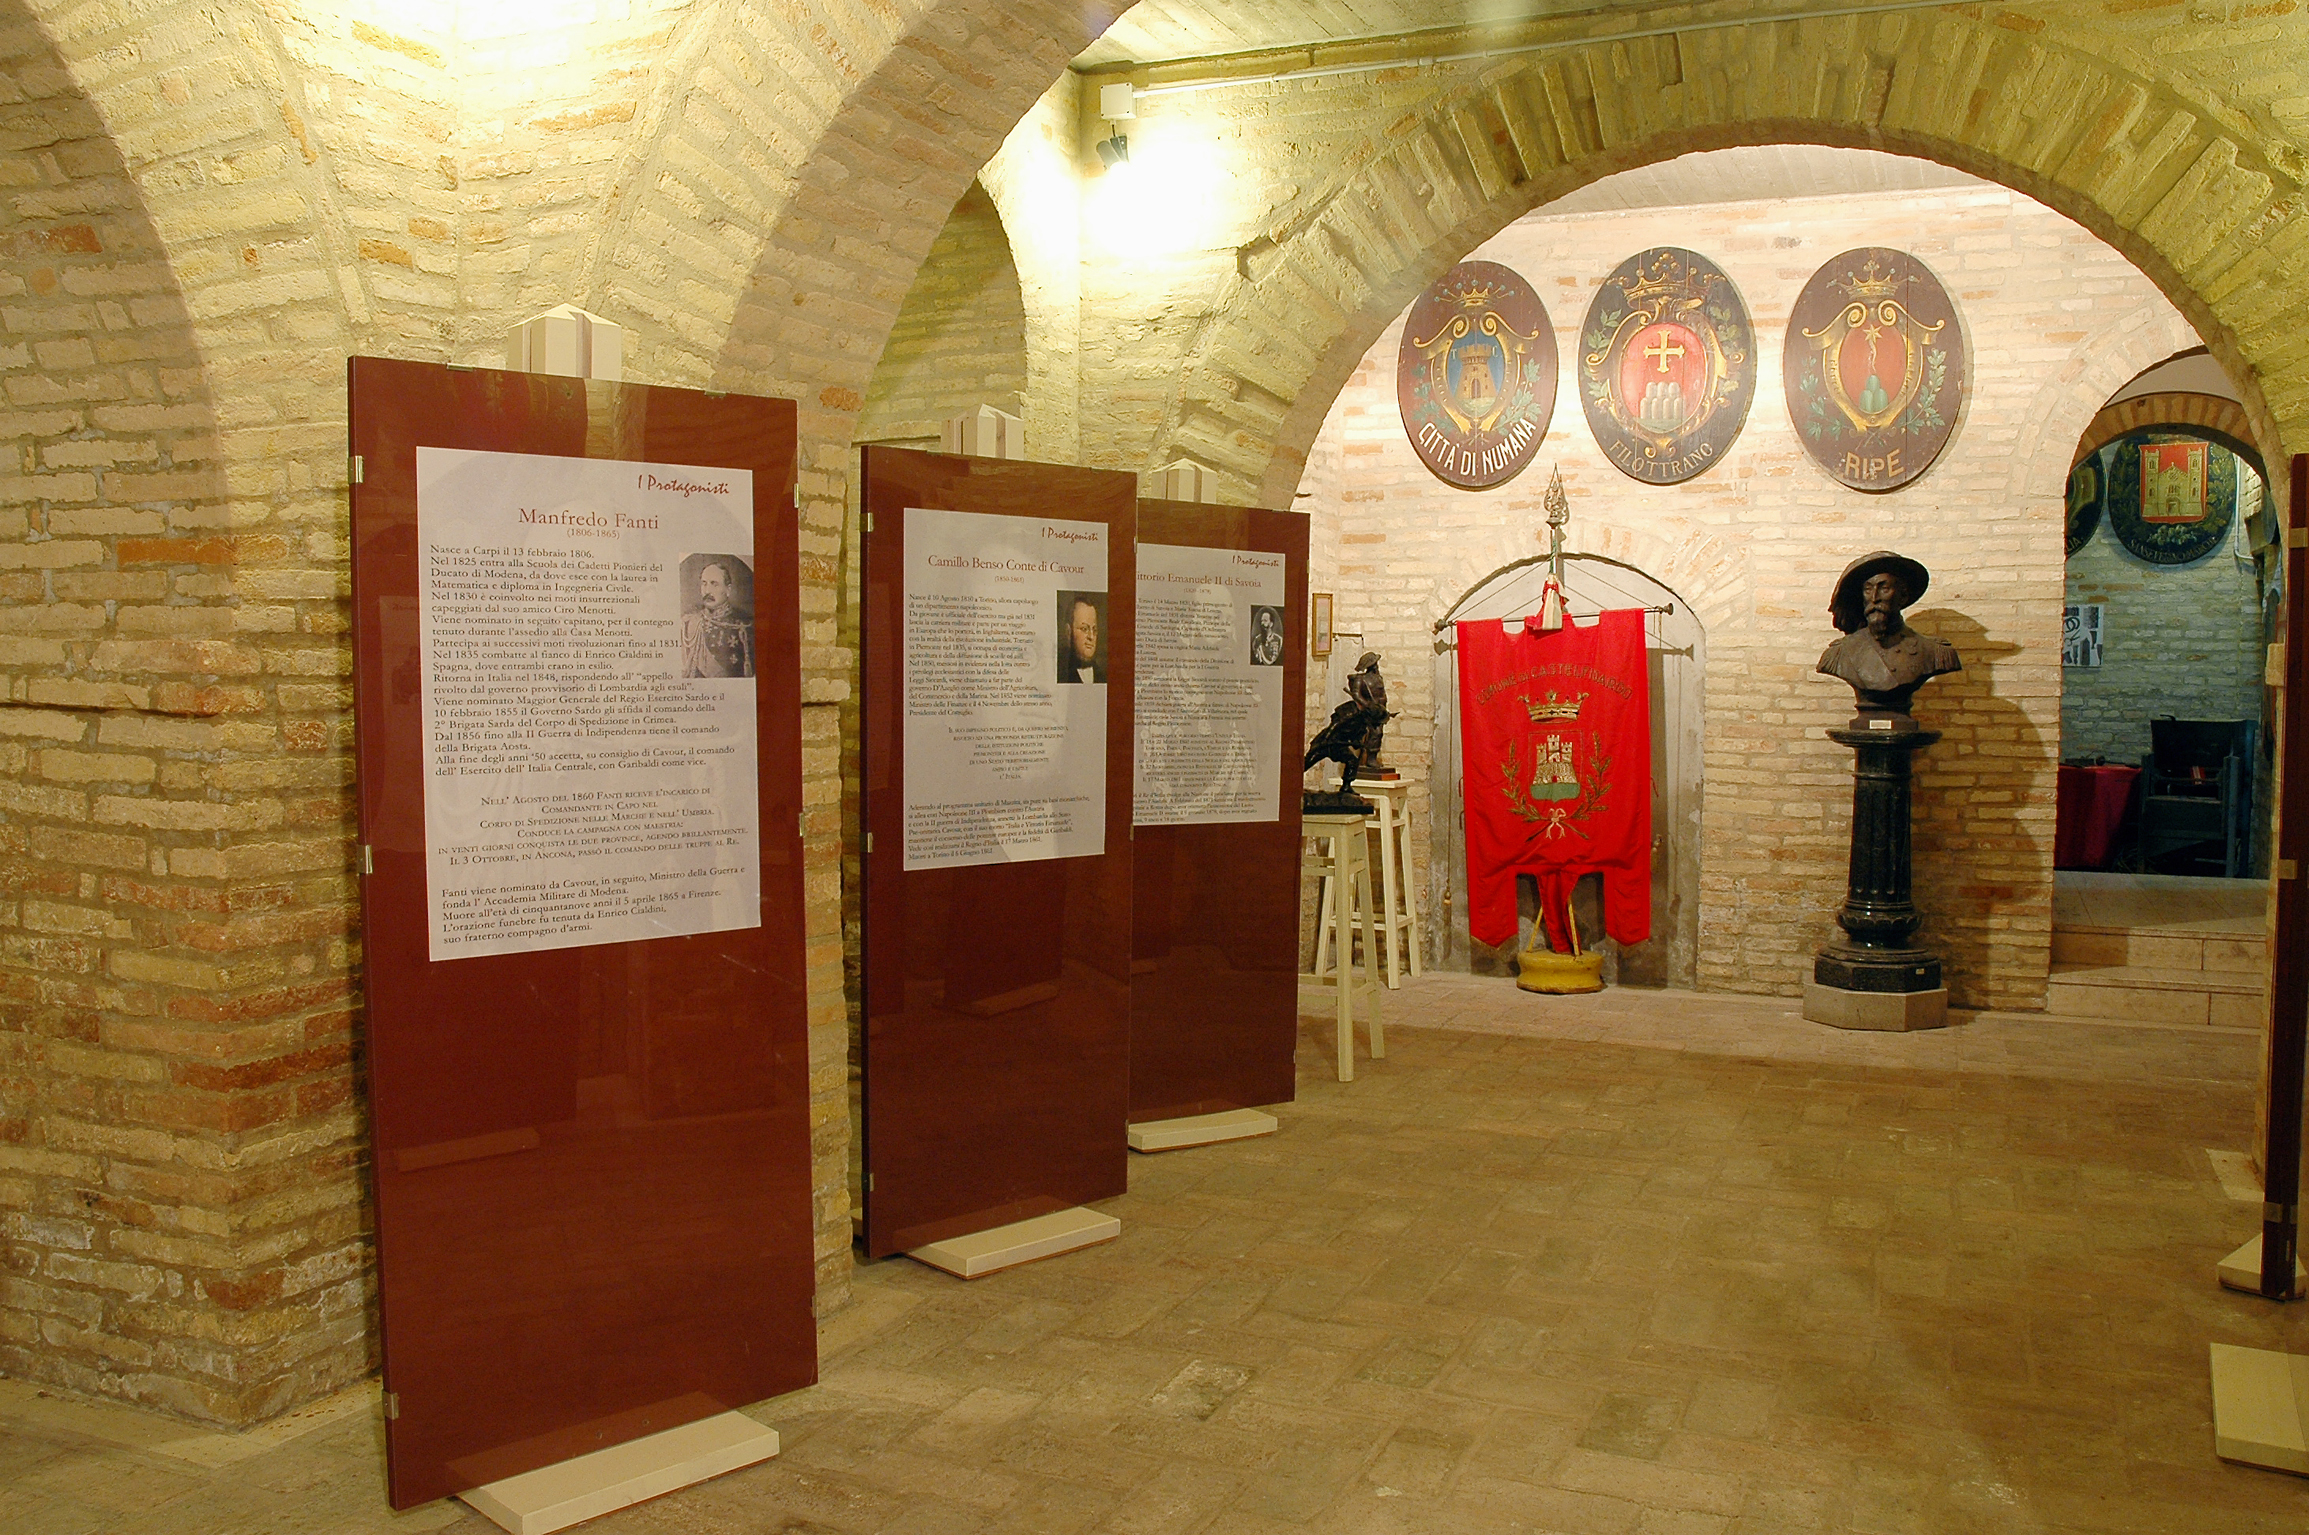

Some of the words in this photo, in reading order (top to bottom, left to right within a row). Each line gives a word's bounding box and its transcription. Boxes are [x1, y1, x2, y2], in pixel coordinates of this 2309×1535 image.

[1460, 451, 1477, 476] DI
[1482, 418, 1537, 475] NUMANA
[1609, 439, 1713, 477] FILOTTRANO
[1845, 448, 1905, 480] RIPE
[637, 474, 642, 489] I
[647, 474, 729, 499] Protagonisti
[518, 507, 607, 527] Manfredo
[614, 512, 658, 529] Fanti
[566, 527, 620, 539] (1806-1865)
[1041, 526, 1045, 537] I
[1047, 526, 1098, 544] Protagonisti
[430, 544, 461, 554] Nasce
[472, 545, 500, 557] Carpi
[503, 546, 509, 555] il
[513, 547, 524, 556] 13
[527, 547, 566, 557] febbraio
[430, 556, 448, 565] Nel
[453, 556, 476, 566] 1825
[479, 556, 504, 567] entra
[507, 558, 523, 567] alla
[526, 559, 557, 569] Scuola
[560, 560, 574, 569] dei
[577, 560, 610, 570] Cadetti
[613, 562, 647, 571] Pionieri
[649, 563, 662, 572] del
[927, 554, 969, 568] Camillo
[972, 556, 1003, 570] Benso
[1005, 558, 1036, 571] Conte
[1037, 560, 1047, 572] di
[1049, 561, 1084, 576] Cavour
[1232, 554, 1235, 563] I
[1236, 554, 1279, 570] Protagonisti
[431, 567, 468, 577] Ducato
[471, 568, 481, 577] di
[528, 570, 540, 579] da
[543, 570, 565, 580] dove
[610, 573, 618, 581] la
[620, 573, 647, 582] laurea
[649, 574, 658, 582] in
[1137, 570, 1165, 582] ittorio
[430, 579, 488, 589] Matematica
[500, 581, 539, 592] diploma
[542, 582, 551, 590] in
[555, 582, 603, 594] Ingegneria
[431, 591, 449, 600] Nel
[454, 591, 477, 600] 1830
[480, 592, 486, 601] è
[488, 591, 534, 602] coinvolto
[537, 593, 551, 602] nei
[554, 594, 576, 602] moti
[579, 594, 640, 604] insurrezionali
[431, 603, 481, 614] capeggiati
[484, 603, 499, 612] dal
[522, 604, 551, 613] amico
[553, 605, 574, 613] Ciro
[432, 613, 461, 623] Viene
[464, 615, 512, 624] nominato
[514, 616, 524, 624] in
[527, 616, 562, 626] seguito
[607, 619, 622, 627] per
[624, 617, 630, 625] il
[632, 619, 674, 628] contegno
[467, 626, 505, 635] durante
[551, 628, 567, 636] alla
[569, 626, 591, 636] Casa
[432, 638, 479, 648] Partecipa
[481, 638, 490, 647] ai
[493, 638, 540, 647] successivi
[543, 639, 565, 647] moti
[568, 639, 625, 647] rivoluzionari
[628, 638, 646, 647] fino
[648, 639, 656, 647] al
[433, 650, 451, 659] Nel
[455, 648, 478, 659] 1835
[481, 650, 526, 659] combatte
[529, 650, 538, 658] al
[541, 649, 570, 658] fianco
[572, 650, 581, 658] di
[585, 650, 615, 658] Enrico
[618, 650, 652, 658] Cialdini
[654, 650, 663, 658] in
[474, 661, 498, 670] dove
[501, 661, 544, 670] entrambi
[576, 661, 585, 669] in
[442, 898, 471, 909] fonda
[484, 893, 536, 906] Accademia
[539, 890, 575, 901] Militare
[577, 888, 587, 898] di
[442, 909, 475, 921] Muore
[509, 905, 519, 915] di
[522, 900, 590, 915] cinquantanove
[592, 897, 612, 907] anni
[615, 897, 621, 905] il
[623, 896, 629, 905] 5
[631, 894, 655, 905] aprile
[659, 891, 678, 901] 1865
[498, 915, 536, 927] funebre
[539, 913, 549, 924] fu
[552, 913, 580, 923] tenuta
[583, 910, 594, 919] da
[597, 907, 628, 918] Enrico
[443, 936, 461, 944] suo
[464, 929, 504, 942] fraterno
[507, 927, 557, 940] compagno
